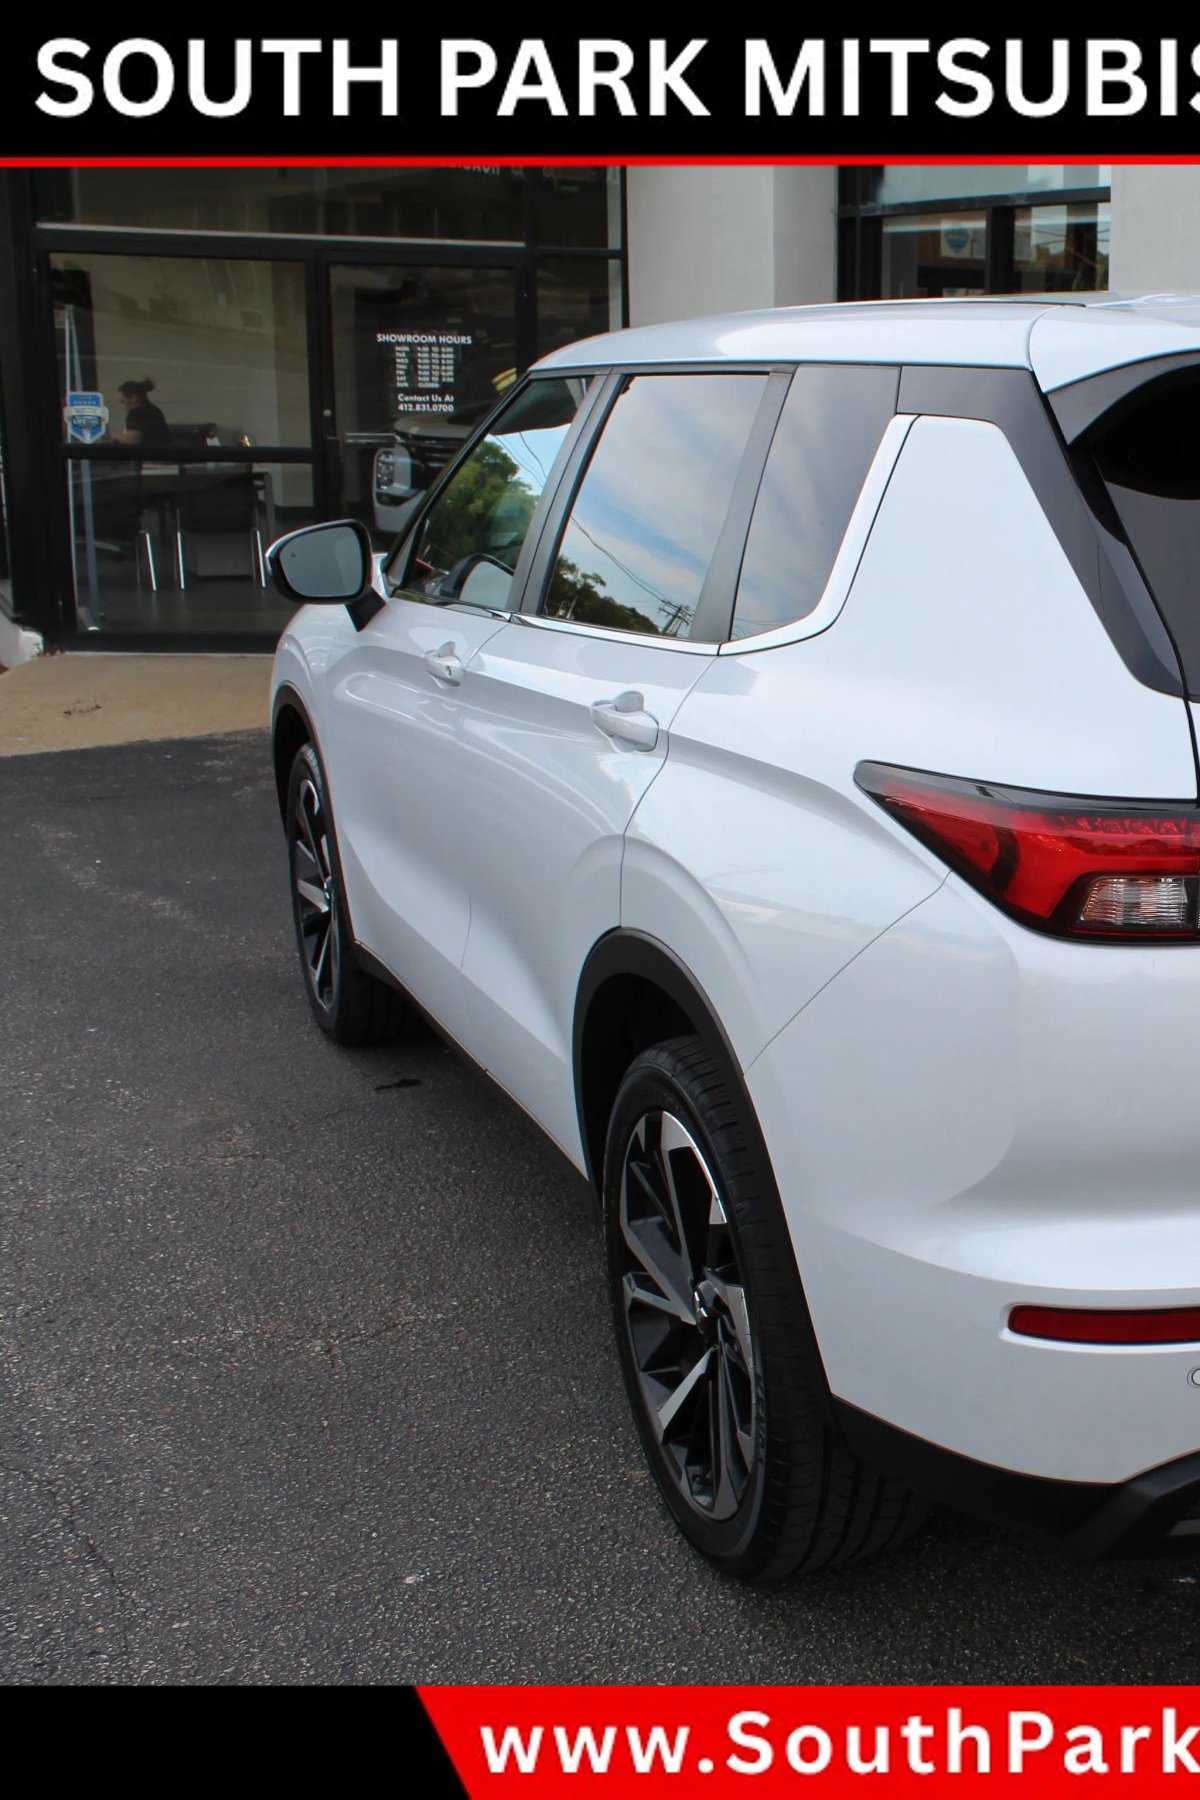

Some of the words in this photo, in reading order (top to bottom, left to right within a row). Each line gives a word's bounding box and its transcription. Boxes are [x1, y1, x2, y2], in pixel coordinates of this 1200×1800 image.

[376, 333, 437, 343] SHOWROOM
[439, 335, 472, 344] HOURS
[398, 393, 429, 402] Contact
[431, 394, 442, 402] Us
[398, 403, 454, 412] 412.831.0700
